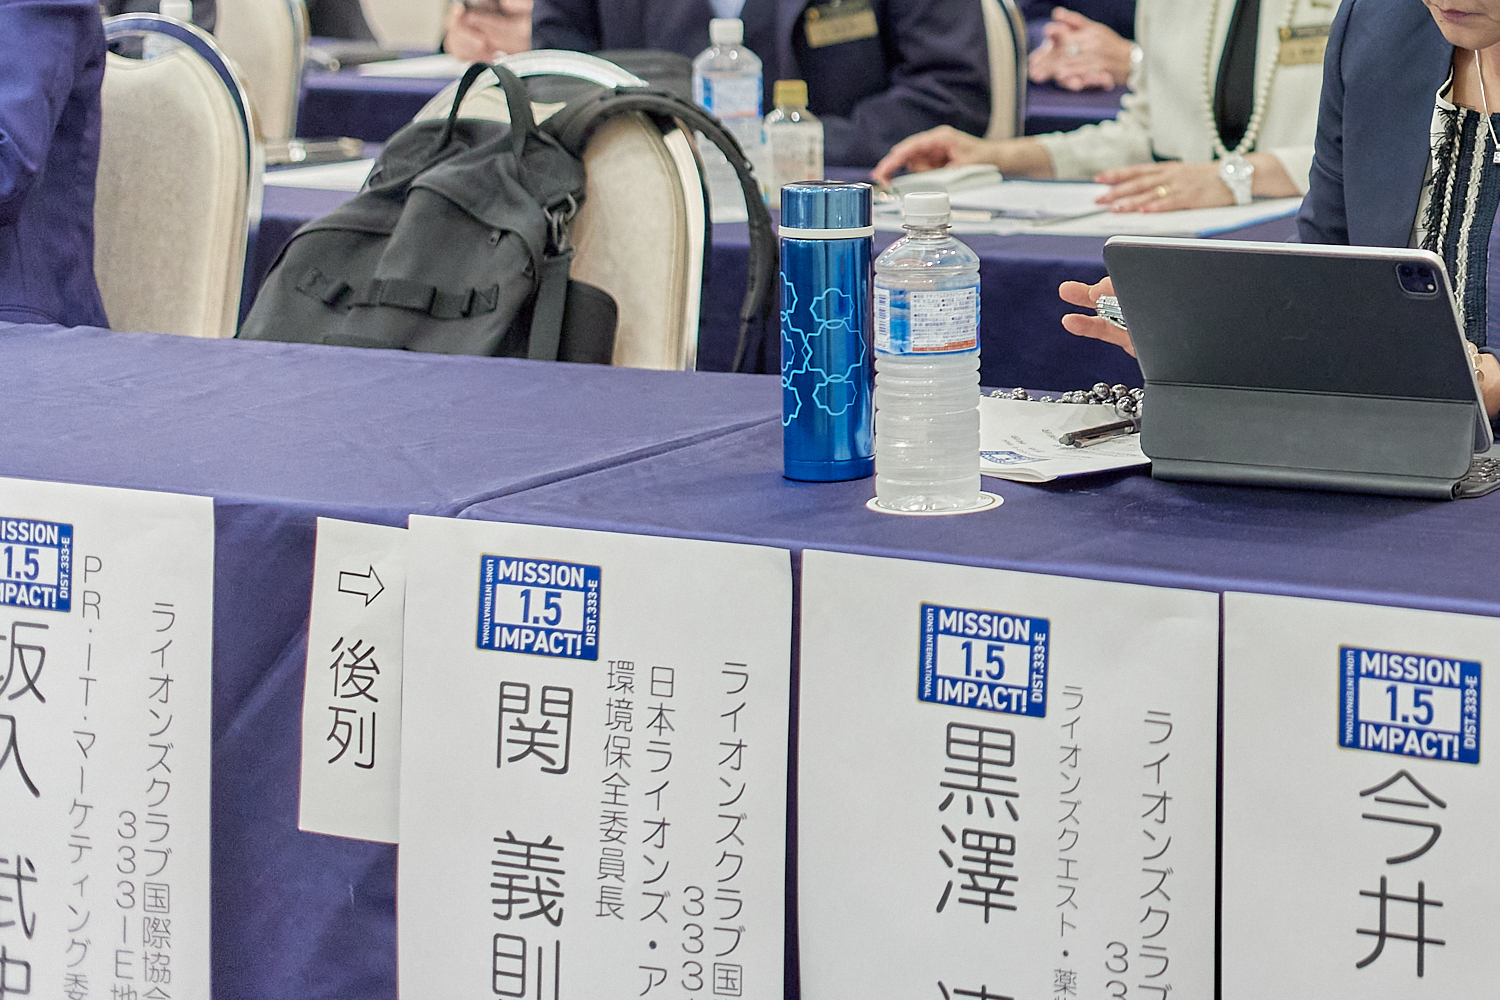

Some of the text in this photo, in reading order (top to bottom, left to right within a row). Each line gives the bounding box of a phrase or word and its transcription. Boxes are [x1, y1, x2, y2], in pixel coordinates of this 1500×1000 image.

[4, 546, 40, 580] 1.5
[60, 536, 70, 599] DIST.333-E
[499, 559, 585, 588] MISSION
[0, 583, 57, 608] PACT!
[482, 559, 494, 646] LIONS INTERNATIONAL
[520, 588, 563, 626] 1.5
[585, 580, 598, 646] DIST.333-E
[938, 609, 1031, 641] MISSION
[494, 626, 582, 656] IMPACT!
[924, 608, 934, 698] LIONS INTERNATIONAL
[961, 640, 1006, 680] 1.5
[1032, 632, 1046, 703] DIST.333-E
[1360, 651, 1461, 685] MISSION
[327, 637, 380, 769] 後列
[936, 678, 1028, 713] IMPACT!
[1386, 684, 1434, 726] 1.5
[1464, 675, 1478, 750] DIST.333-E
[497, 681, 573, 775] 関
[1359, 723, 1460, 760] IMPACT!
[595, 660, 635, 921] 環境保全委員長
[936, 722, 1020, 924] 黒澤
[1054, 685, 1084, 1000] ライオンズクエスト・薬
[1356, 769, 1447, 978] 今井
